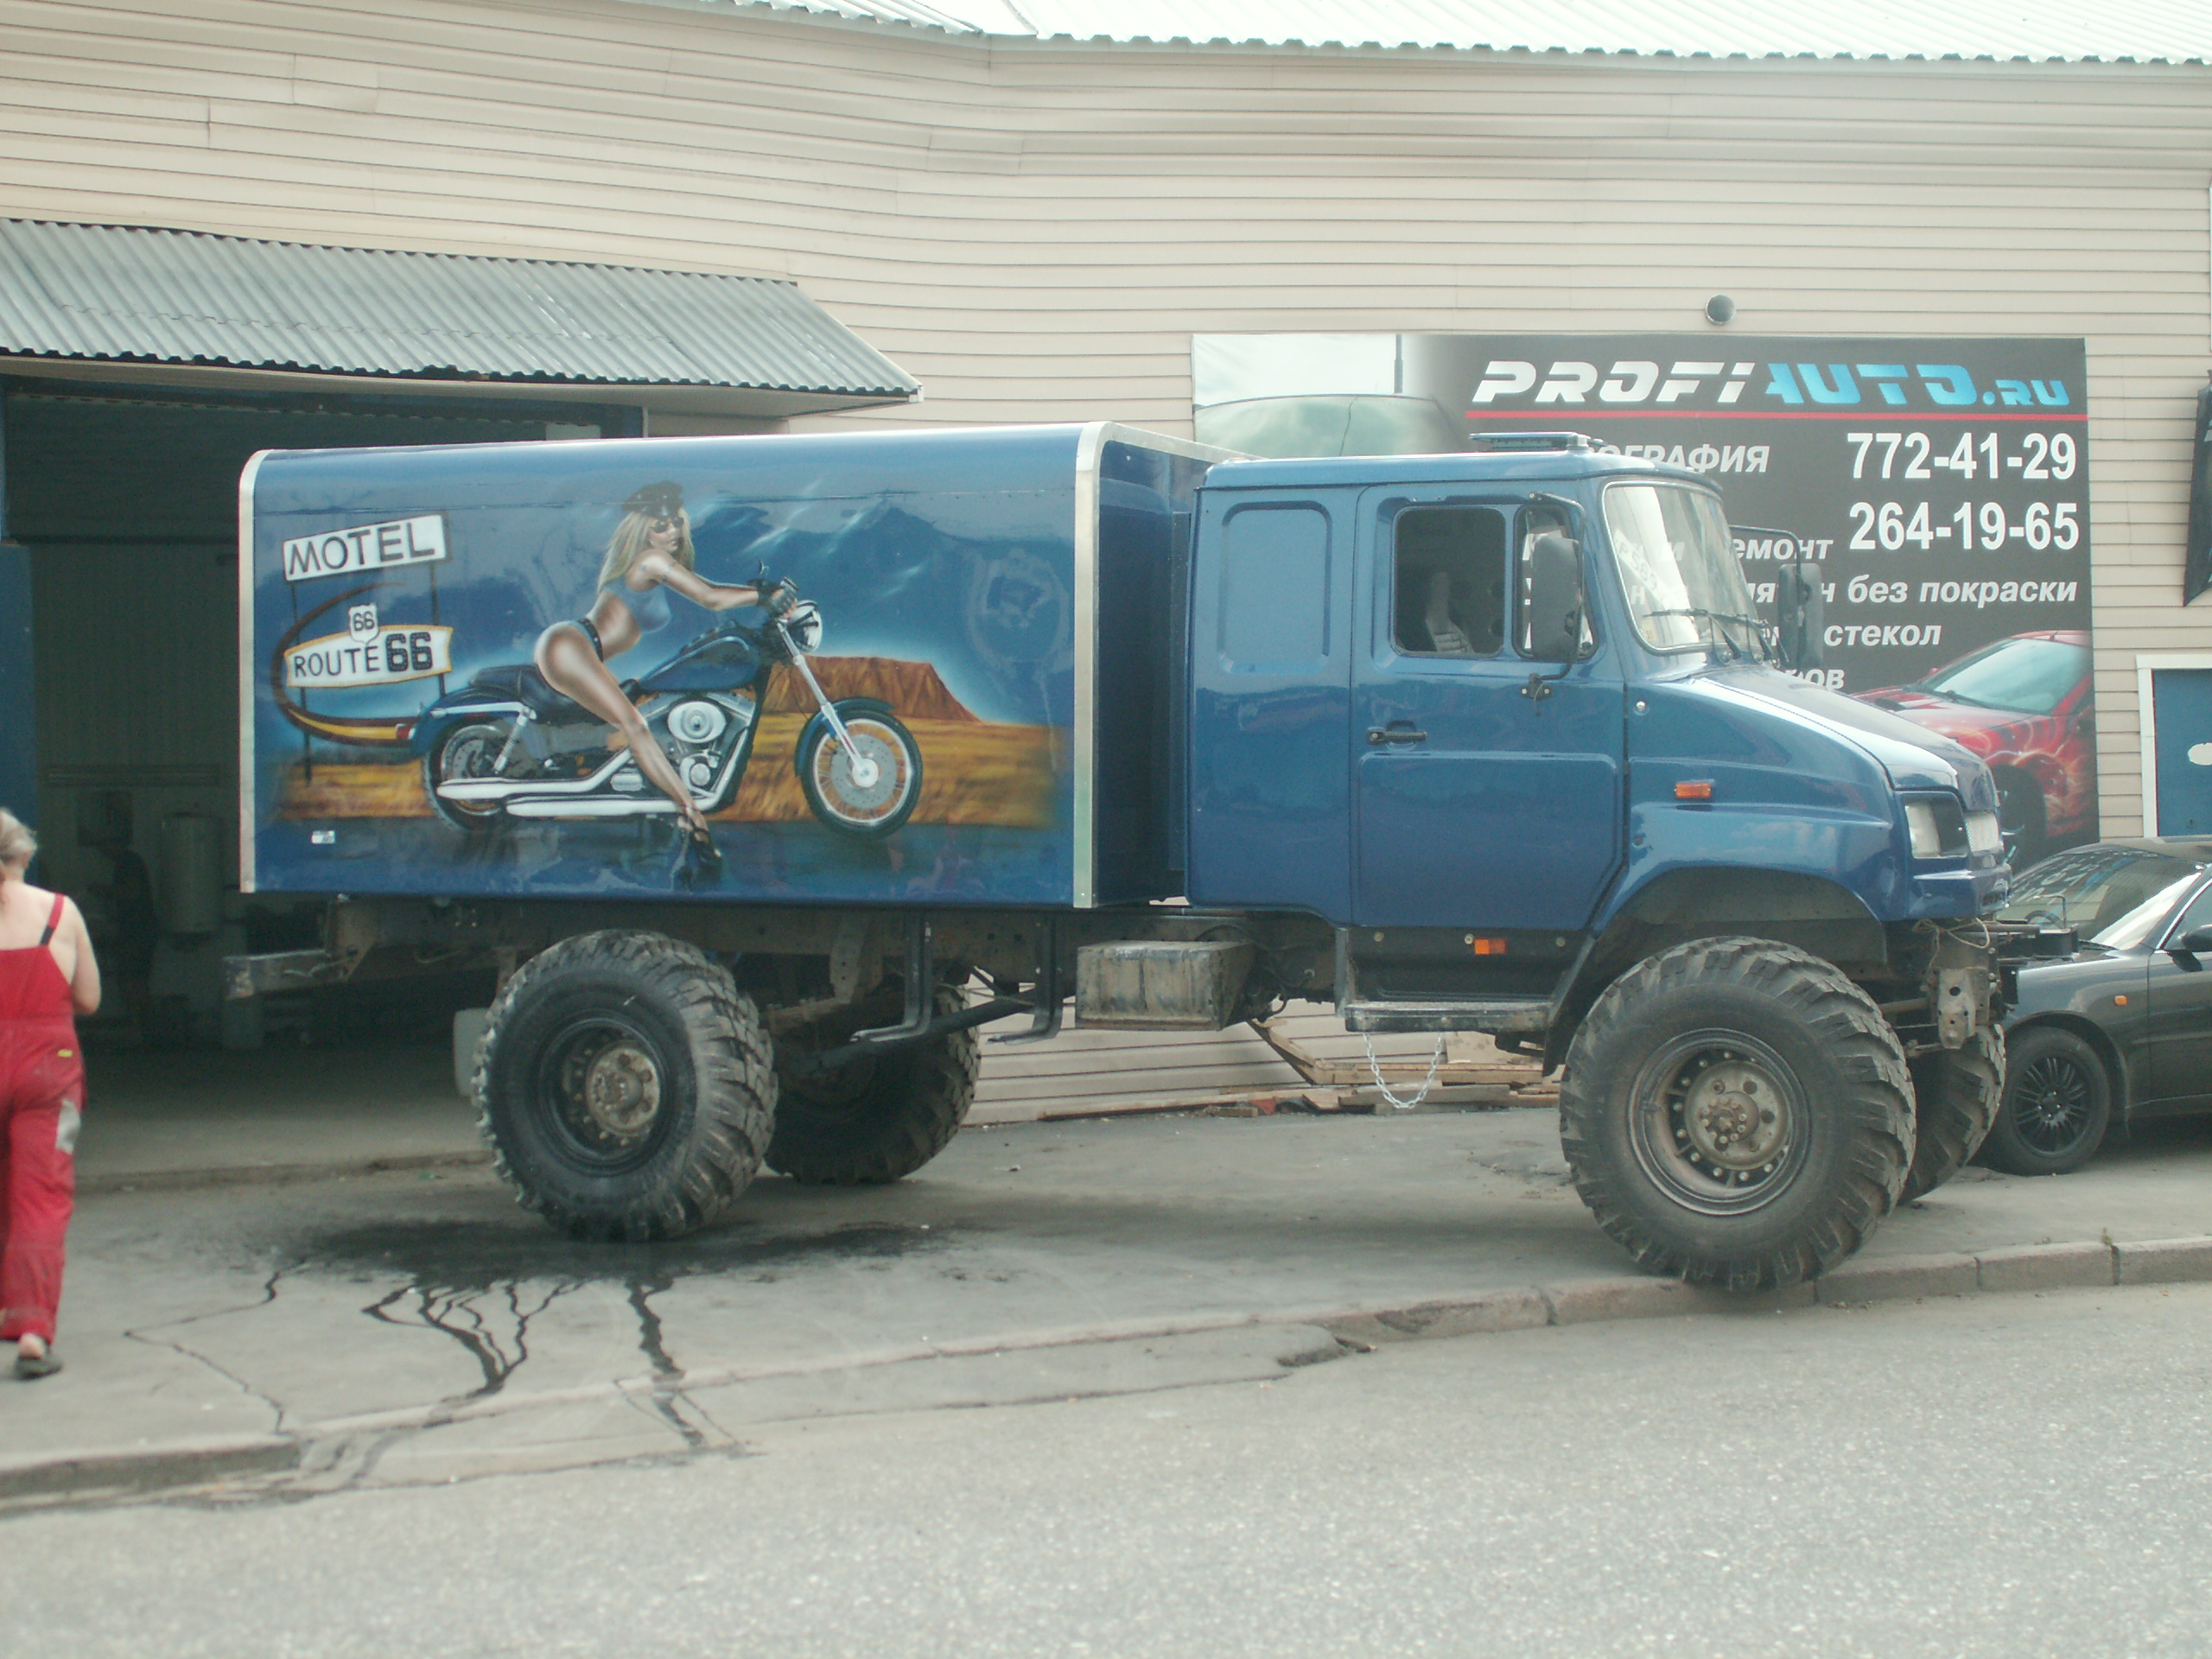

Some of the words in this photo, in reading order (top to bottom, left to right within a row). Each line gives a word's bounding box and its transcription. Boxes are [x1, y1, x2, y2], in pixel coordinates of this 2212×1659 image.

[1847, 431, 2077, 480] 772-41-29
[289, 522, 435, 576] MOTEL
[1848, 501, 2080, 550] 264-19-65
[1847, 574, 1909, 604] без
[1919, 581, 2078, 609] покраски
[353, 610, 376, 632] 66
[1823, 624, 1942, 646] стекол
[294, 645, 381, 678] ROUTE
[385, 631, 434, 673] 66
